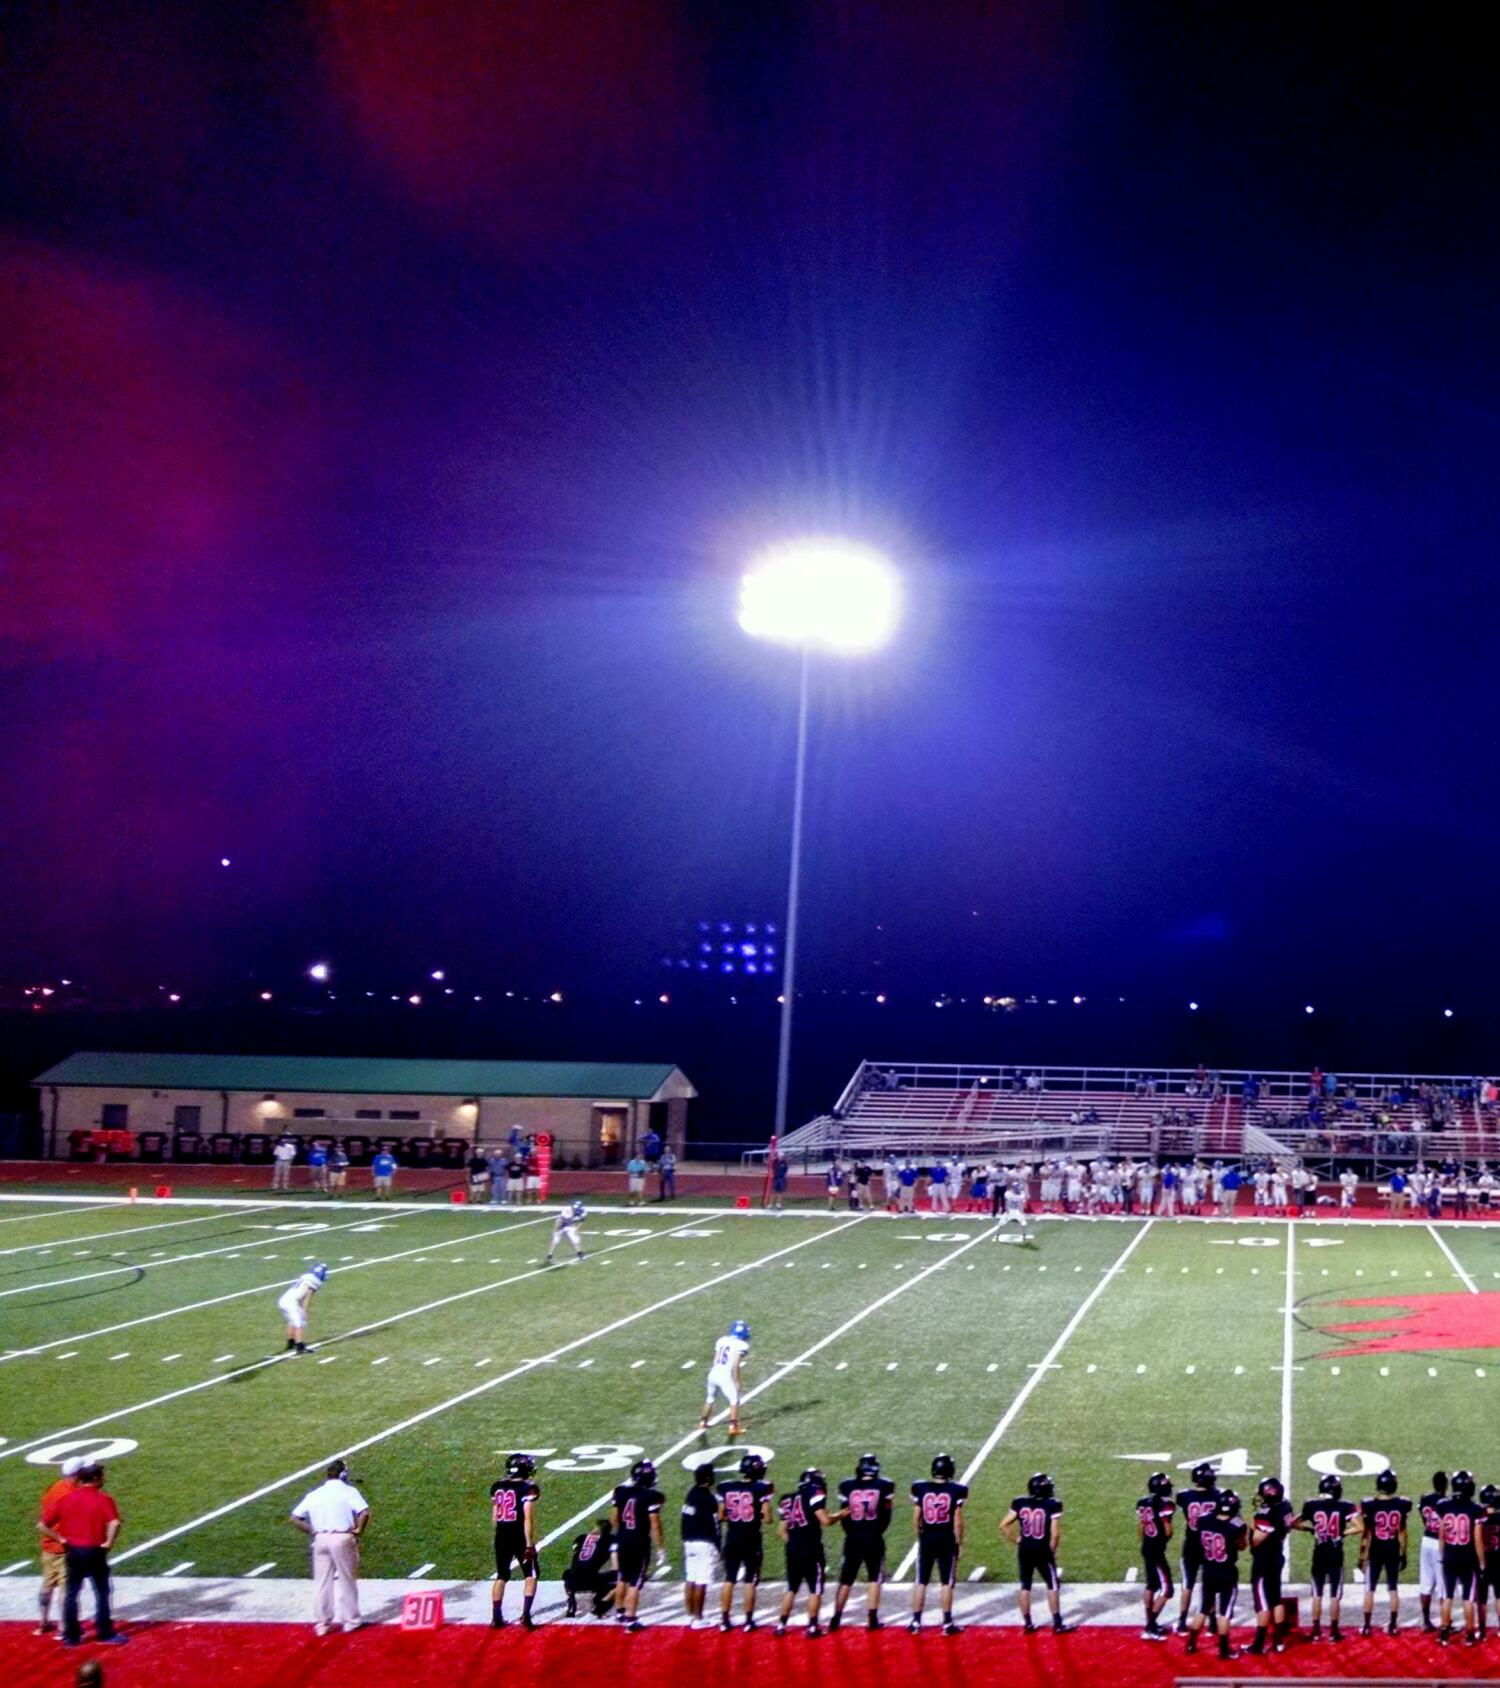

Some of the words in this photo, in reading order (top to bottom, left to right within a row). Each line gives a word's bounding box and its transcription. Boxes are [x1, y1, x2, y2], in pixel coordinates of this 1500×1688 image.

[716, 1344, 731, 1366] 16
[622, 1498, 637, 1530] 4
[923, 1492, 952, 1524] 62
[579, 1533, 600, 1561] 5
[405, 1596, 434, 1627] 30
